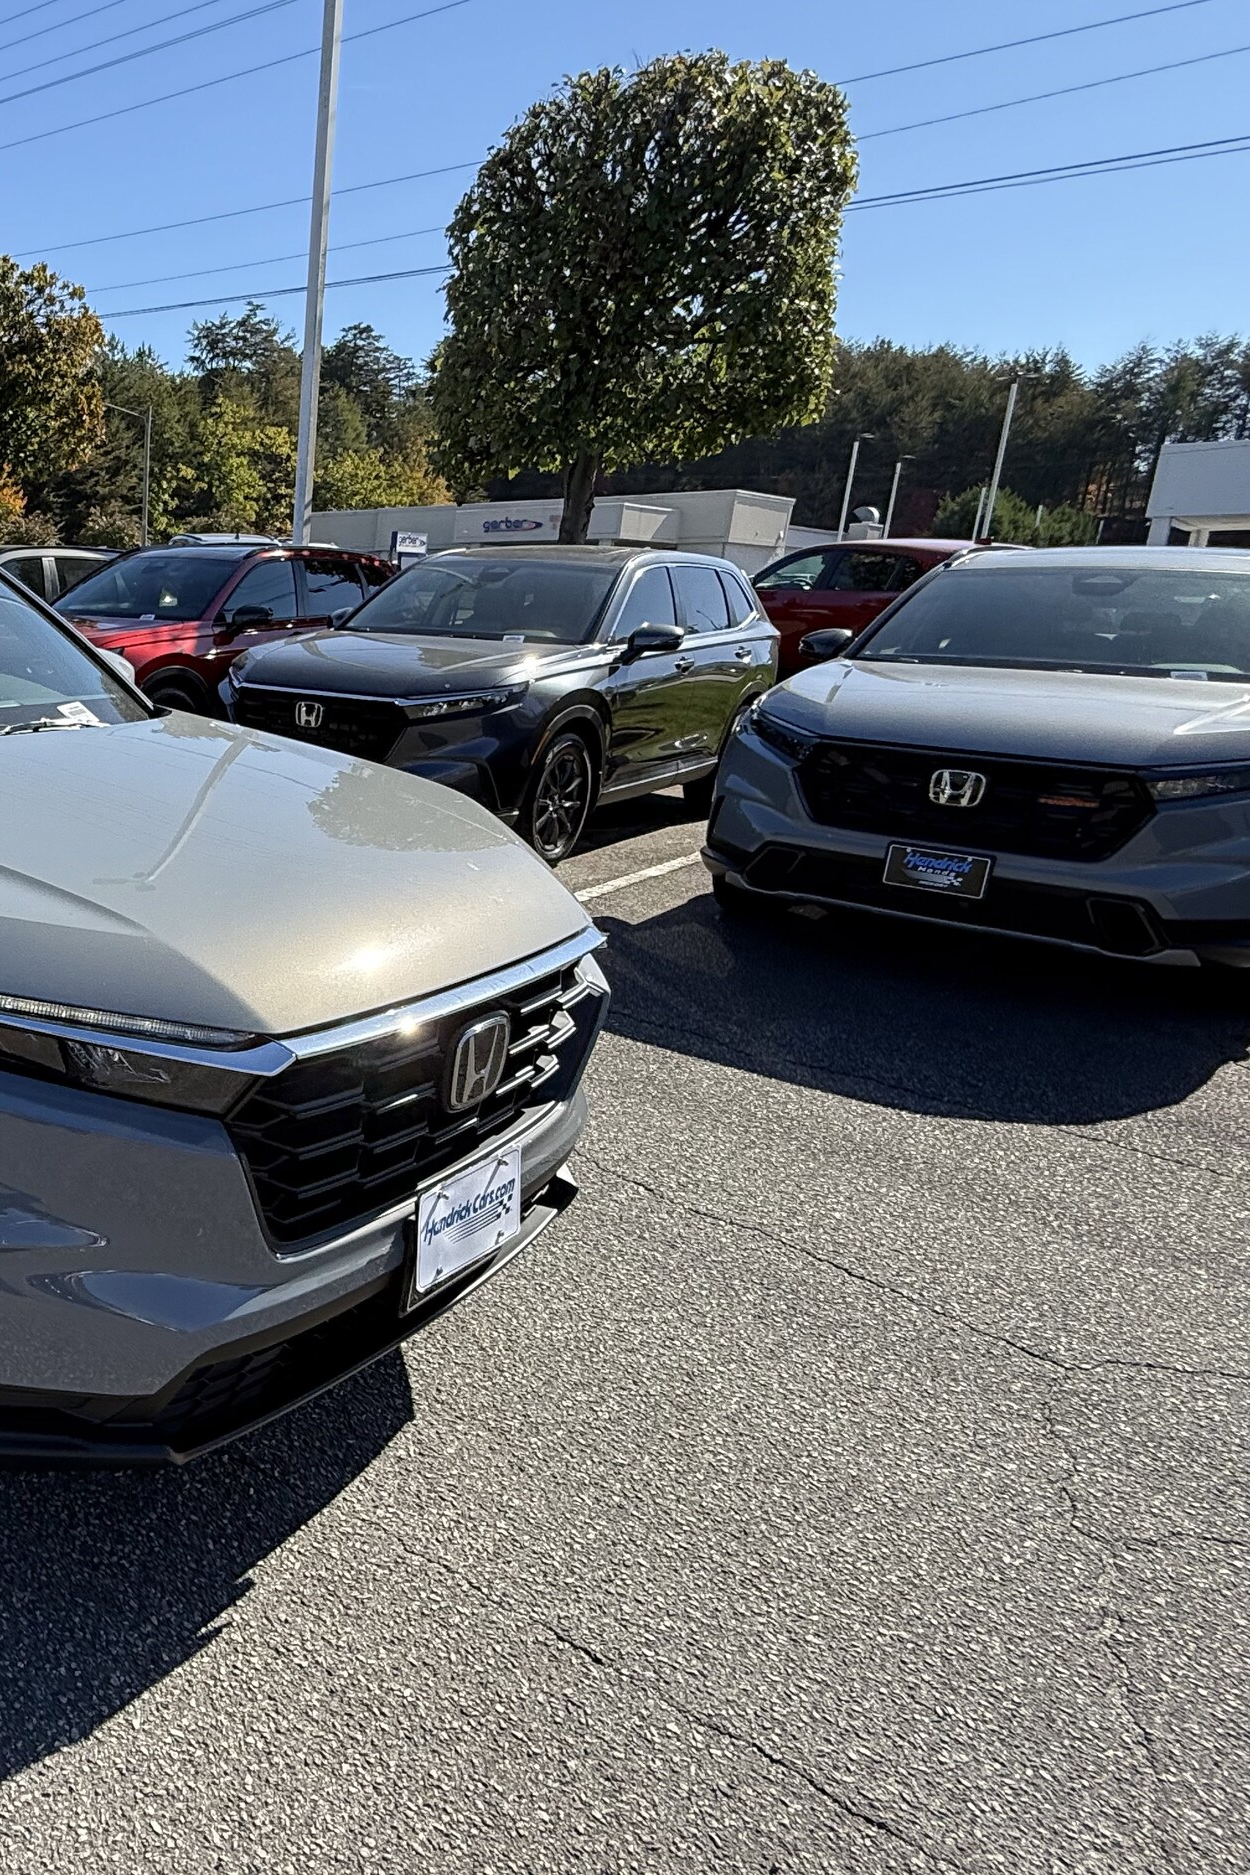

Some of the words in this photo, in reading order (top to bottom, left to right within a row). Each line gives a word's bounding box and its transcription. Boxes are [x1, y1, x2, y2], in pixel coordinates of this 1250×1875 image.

[482, 516, 528, 533] gerber
[902, 851, 973, 873] Hendrick
[917, 866, 957, 877] Honda
